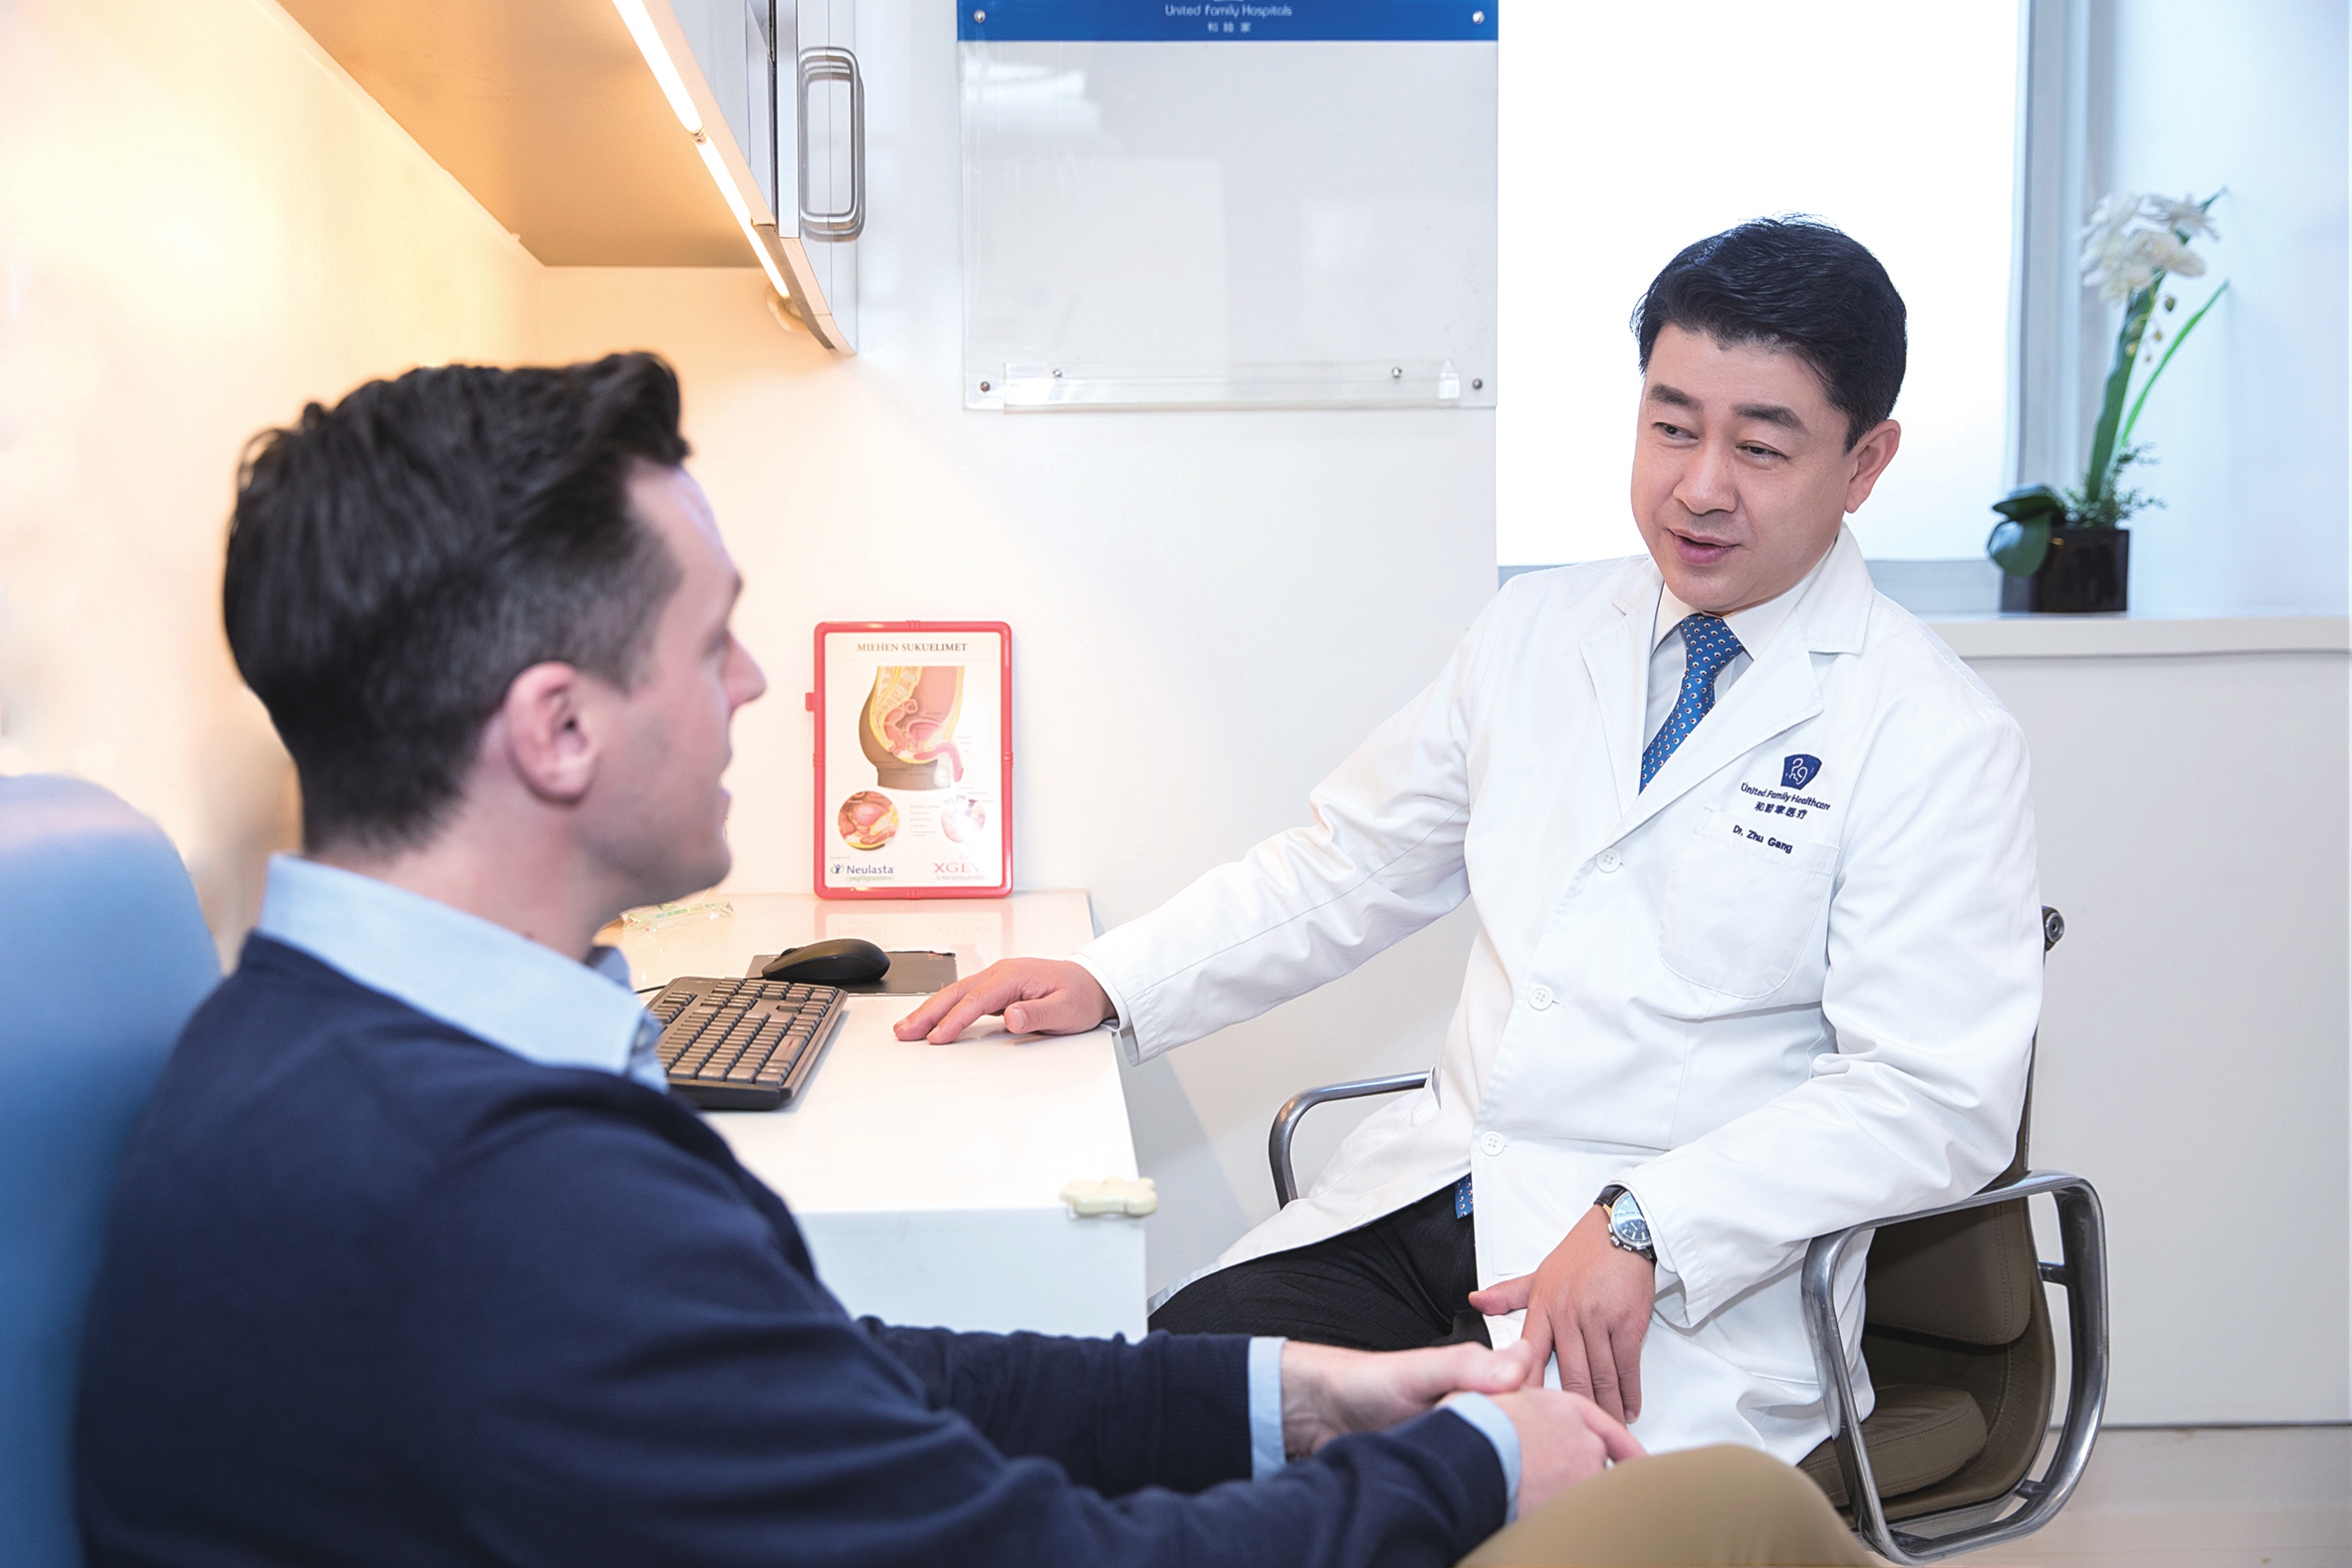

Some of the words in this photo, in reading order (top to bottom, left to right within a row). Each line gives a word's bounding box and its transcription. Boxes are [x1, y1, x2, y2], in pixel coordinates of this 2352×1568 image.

[1165, 4, 1201, 17] United
[1205, 4, 1240, 19] Family
[1242, 4, 1293, 19] Hospitals
[856, 643, 899, 652] MIEHEN
[901, 643, 968, 652] SUKUELIMET
[1740, 783, 1767, 797] United
[1766, 789, 1791, 802] Family
[1790, 794, 1830, 811] Healthcare
[1733, 824, 1743, 836] Dr.
[1747, 829, 1764, 843] Zhu
[1767, 837, 1792, 854] Gang
[846, 864, 894, 874] Neulasta
